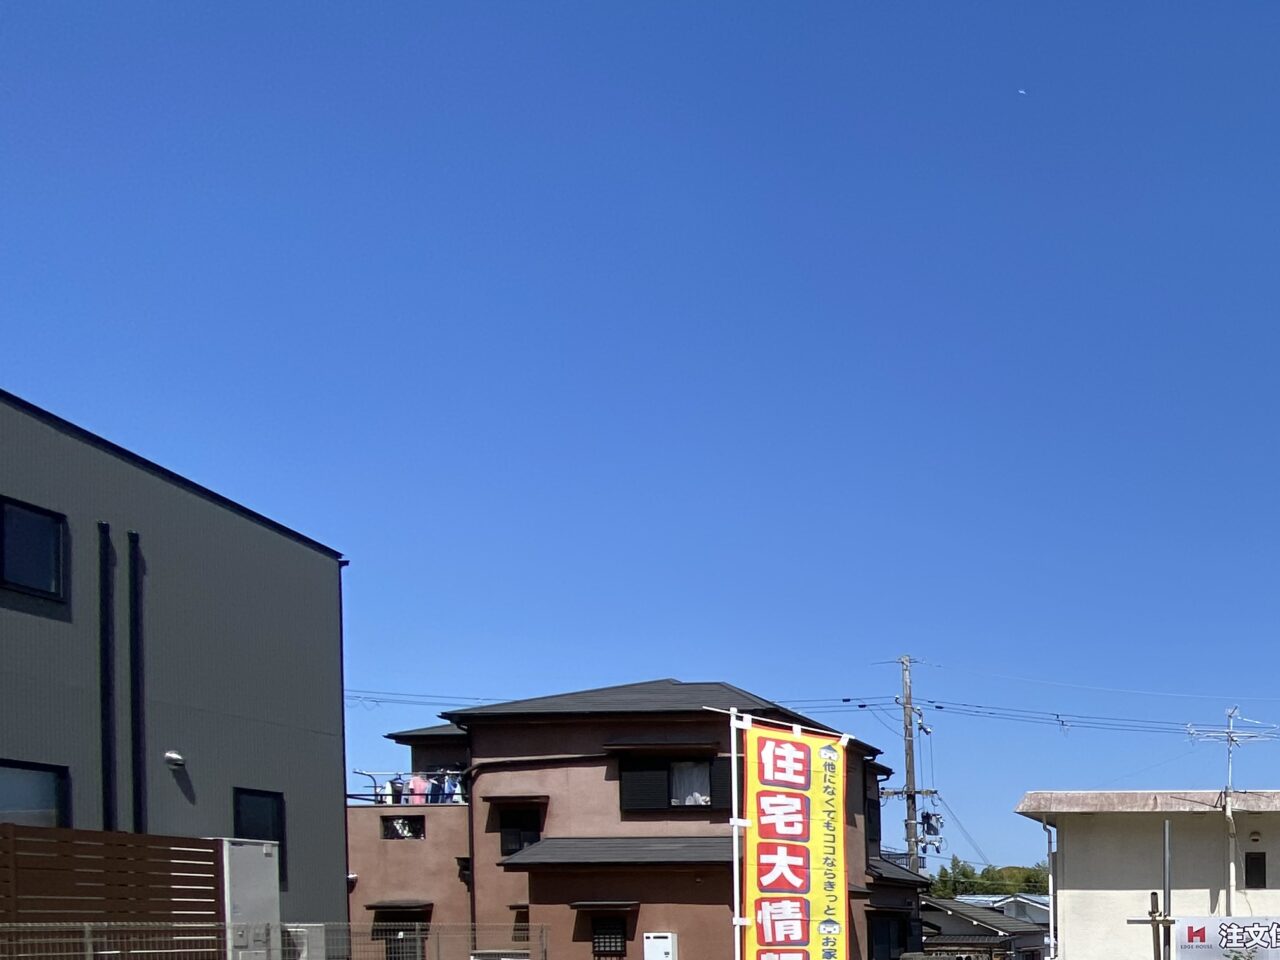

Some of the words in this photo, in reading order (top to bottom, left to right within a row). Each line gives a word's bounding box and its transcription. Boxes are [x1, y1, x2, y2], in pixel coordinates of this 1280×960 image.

[822, 761, 838, 916] 他になくてもココならきっと
